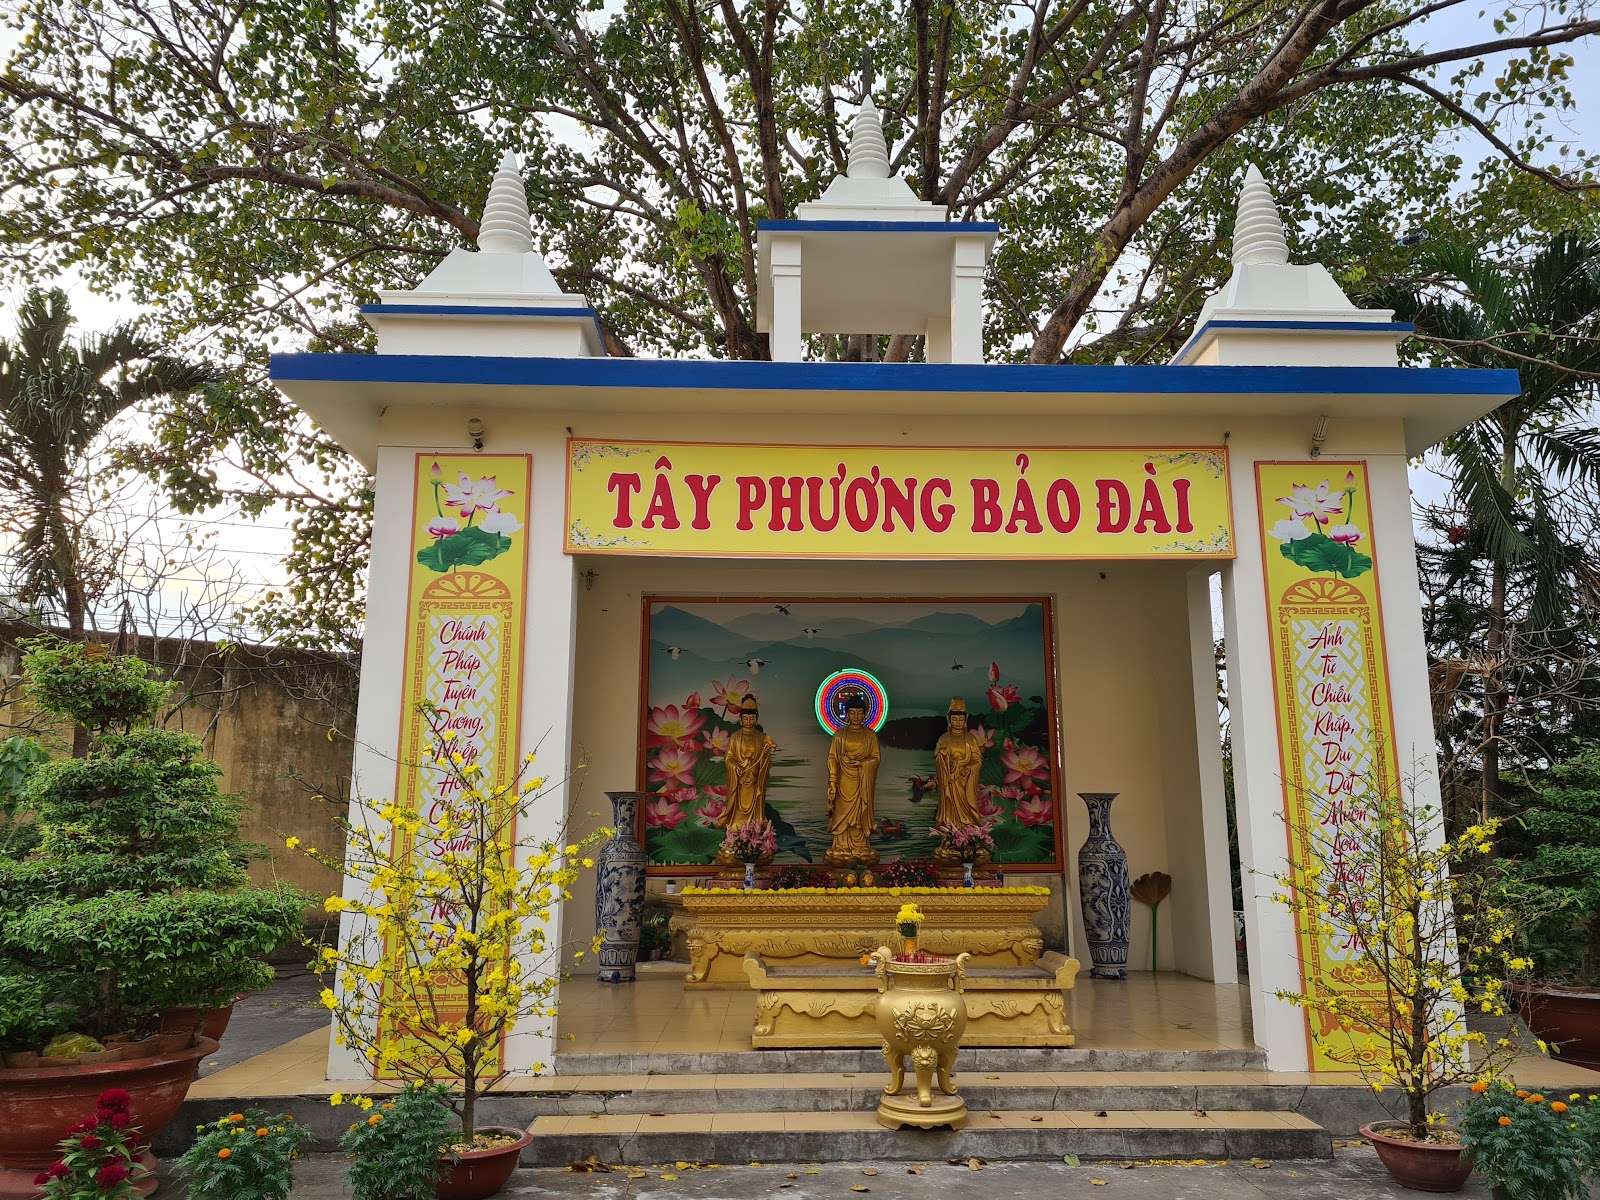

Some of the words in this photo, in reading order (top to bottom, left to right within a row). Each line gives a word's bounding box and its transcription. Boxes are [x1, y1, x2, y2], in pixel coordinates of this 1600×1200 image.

[608, 457, 720, 530] TÂY
[736, 463, 956, 533] PHƯƠNG
[971, 454, 1081, 534] BẢO
[1096, 463, 1194, 534] ĐÀI
[439, 620, 487, 645] Chánh
[1307, 622, 1345, 650] Ánh
[442, 648, 481, 680] Pháp
[1320, 653, 1338, 678] Từ
[443, 678, 477, 710] Tuyên
[1311, 682, 1353, 707] Chiếu
